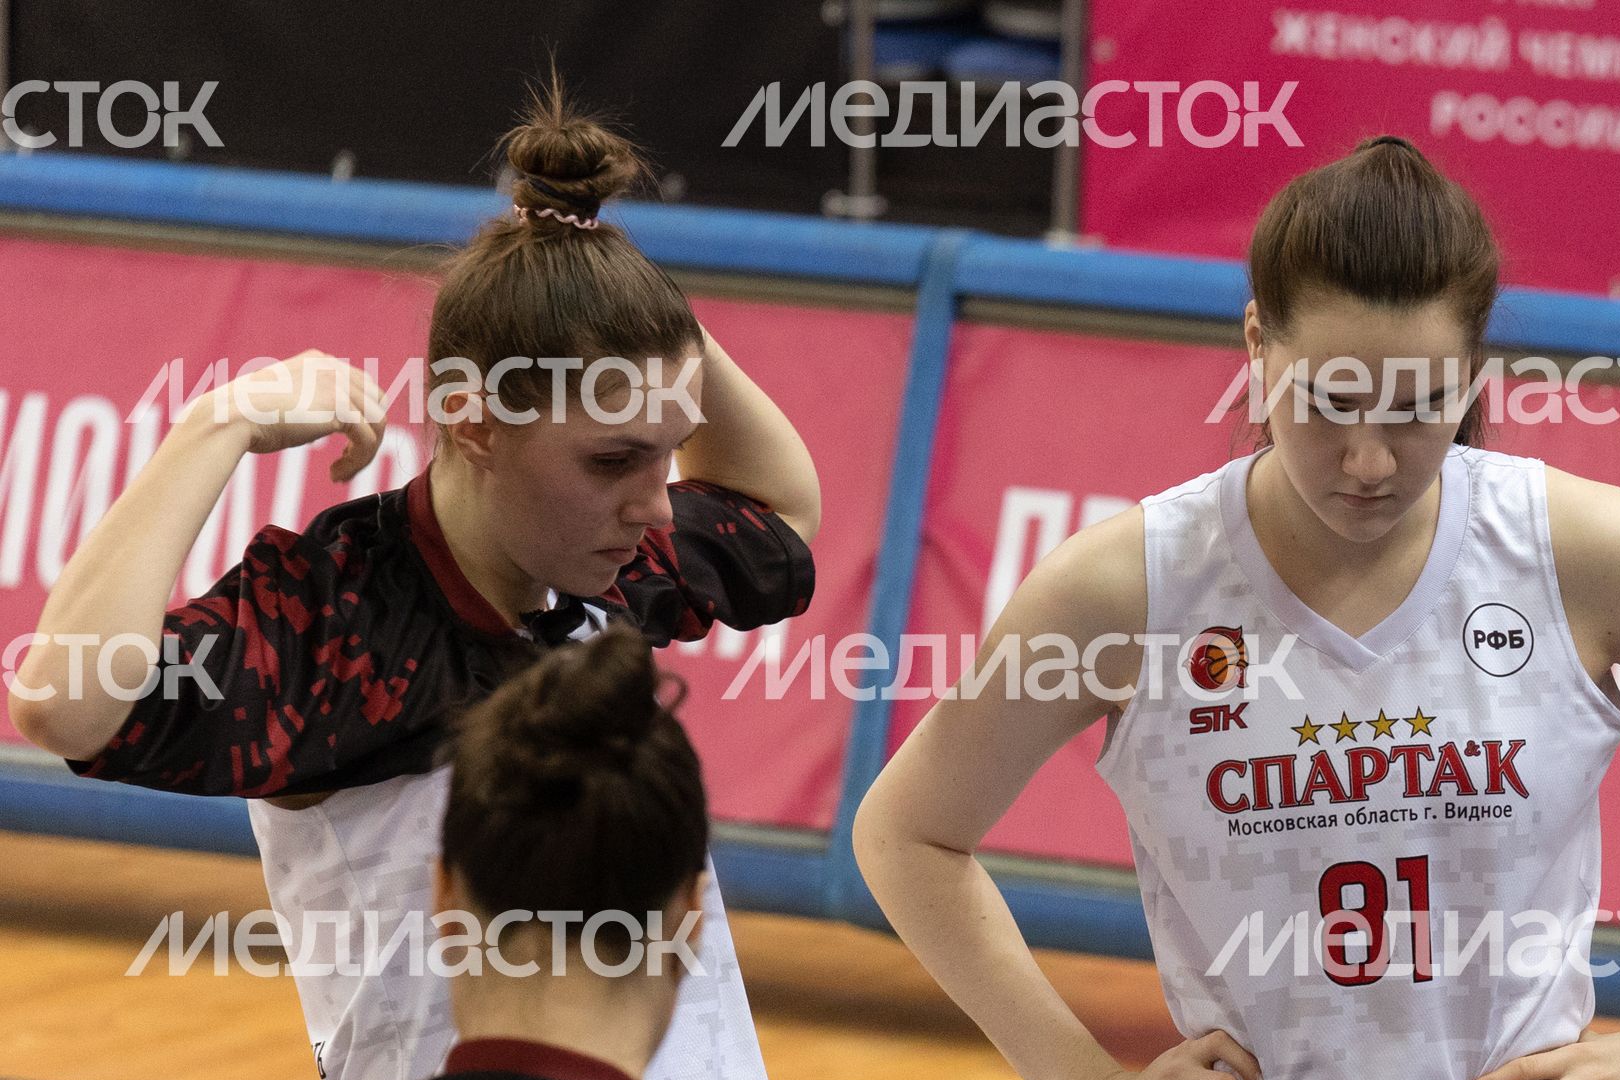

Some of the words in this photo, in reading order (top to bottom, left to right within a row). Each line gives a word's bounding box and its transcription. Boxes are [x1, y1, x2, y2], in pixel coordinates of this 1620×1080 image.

[1472, 628, 1526, 651] РФБ
[1189, 701, 1250, 735] STK
[1227, 811, 1338, 837] Московская
[1344, 806, 1419, 827] область
[1423, 807, 1438, 822] г.
[1444, 802, 1514, 824] Видное
[1318, 854, 1433, 987] 81
